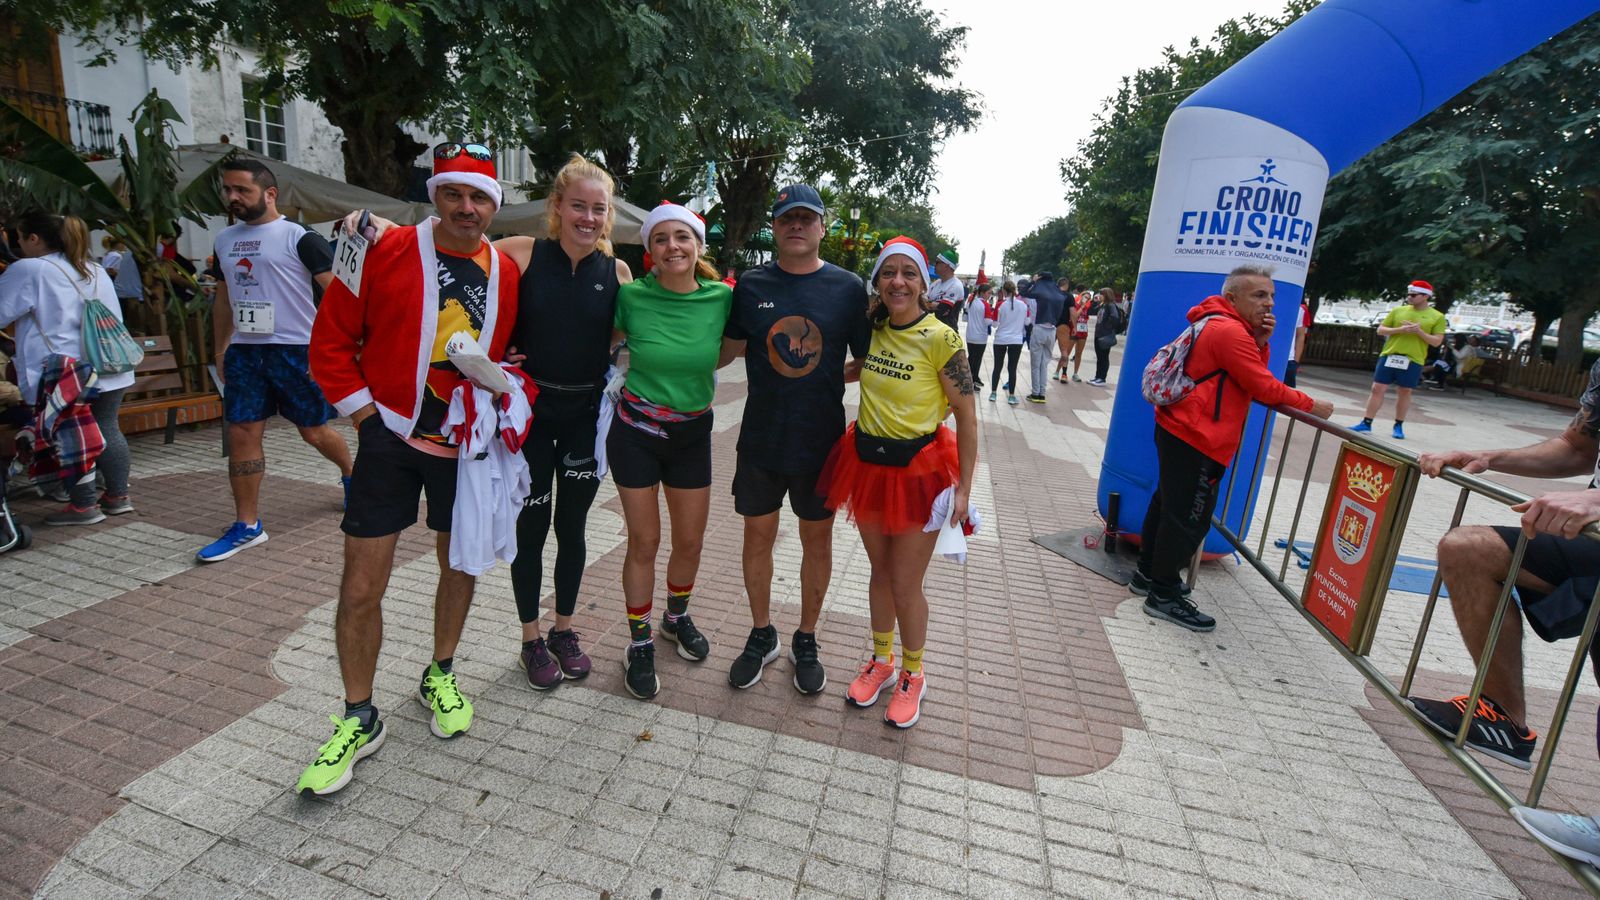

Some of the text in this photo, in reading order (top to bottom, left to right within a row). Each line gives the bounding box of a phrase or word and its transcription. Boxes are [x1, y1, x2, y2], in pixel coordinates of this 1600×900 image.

[1216, 186, 1302, 217] CRONO
[1177, 211, 1313, 258] FINISHER
[340, 241, 358, 274] 176
[1175, 248, 1226, 256] CRONOMETRAJE
[1234, 250, 1282, 261] ORGANIZACIÓN
[464, 285, 480, 305] COPA
[758, 301, 775, 309] FILA
[239, 309, 255, 323] 11
[1328, 567, 1348, 588] Excmo.
[1318, 589, 1346, 619] DE TARIFA
